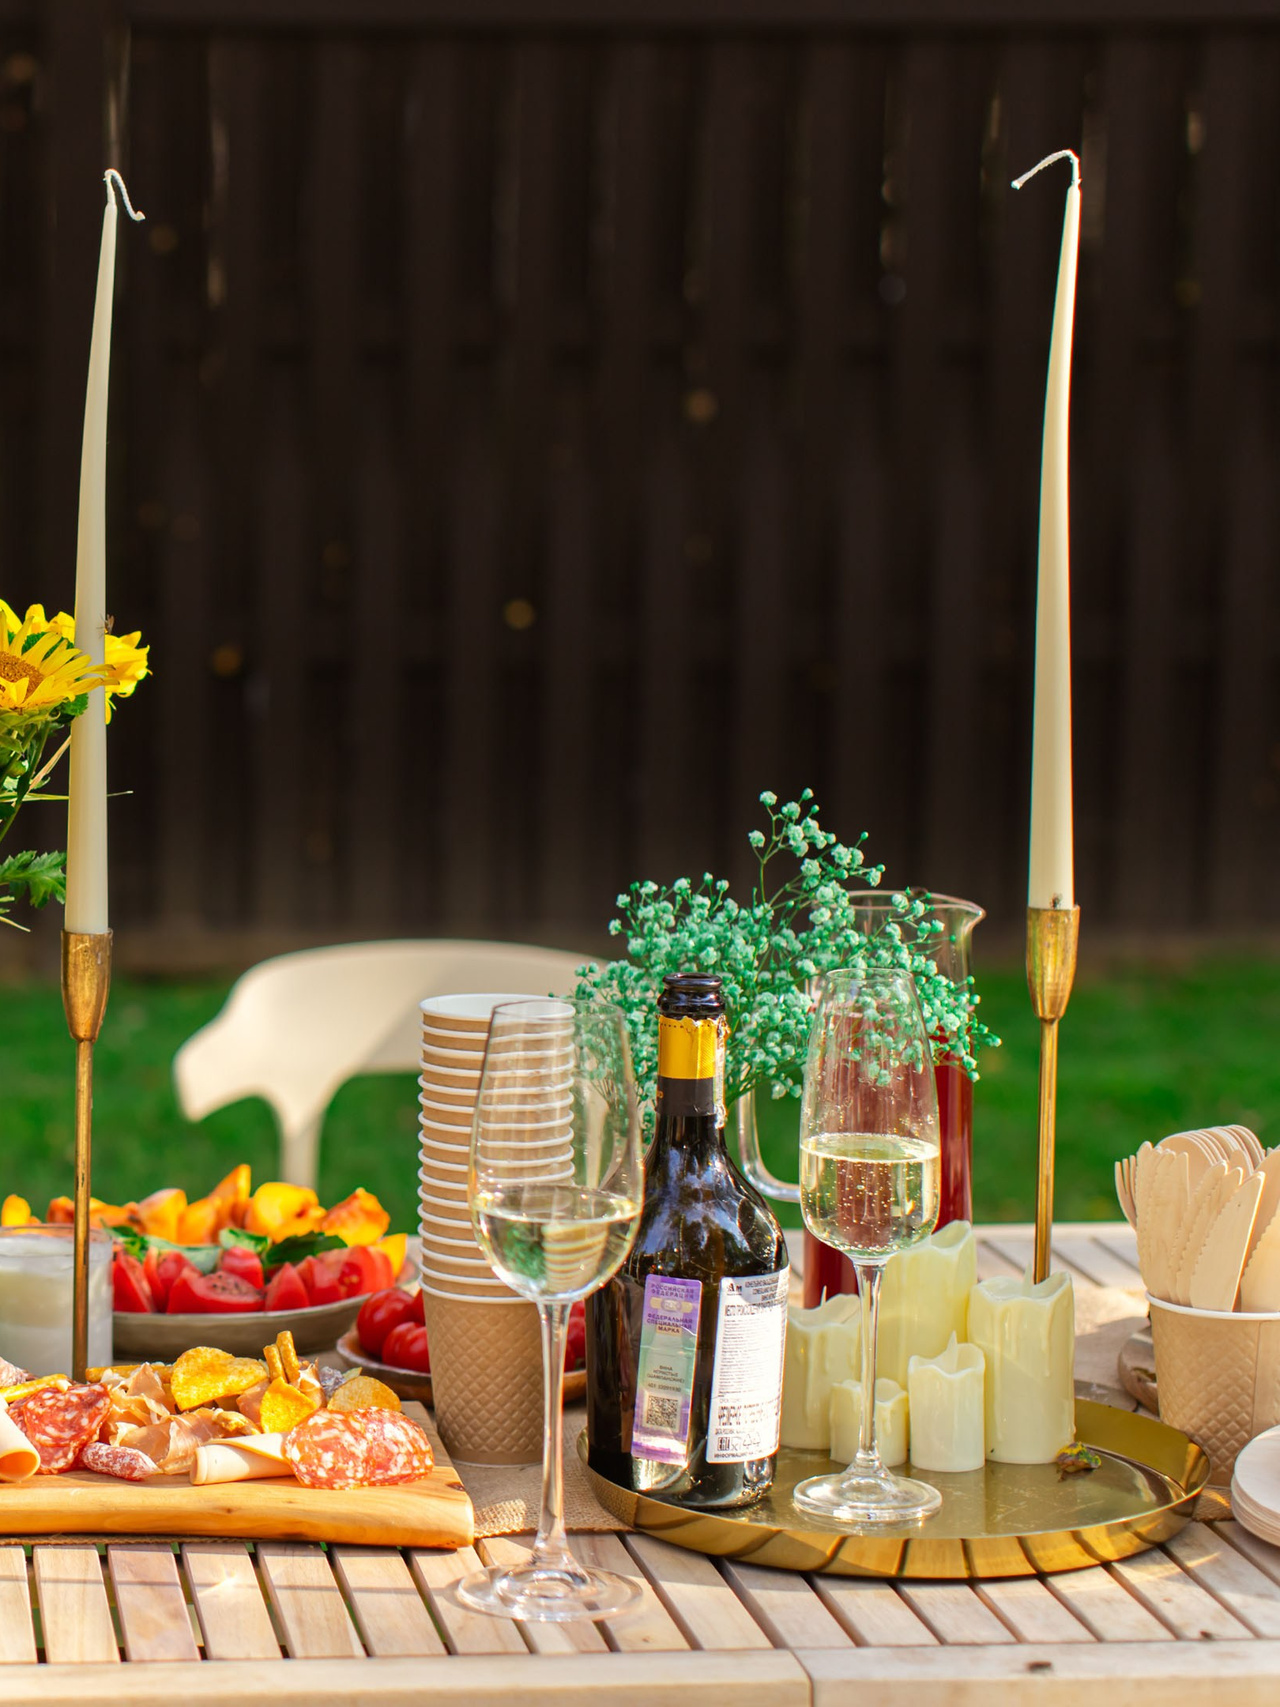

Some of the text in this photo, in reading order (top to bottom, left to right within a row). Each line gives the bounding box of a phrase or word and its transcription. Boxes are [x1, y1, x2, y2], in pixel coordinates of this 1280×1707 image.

[651, 1283, 694, 1293] РОССИЙСКАЯ
[651, 1289, 694, 1299] ФЕДЕРАЦИЯ
[648, 1313, 693, 1323] ФЕДЕРАЛЬНАЯ
[647, 1318, 692, 1329] СПЕЦИАЛЬНАЯ
[658, 1325, 680, 1333] МАРКА
